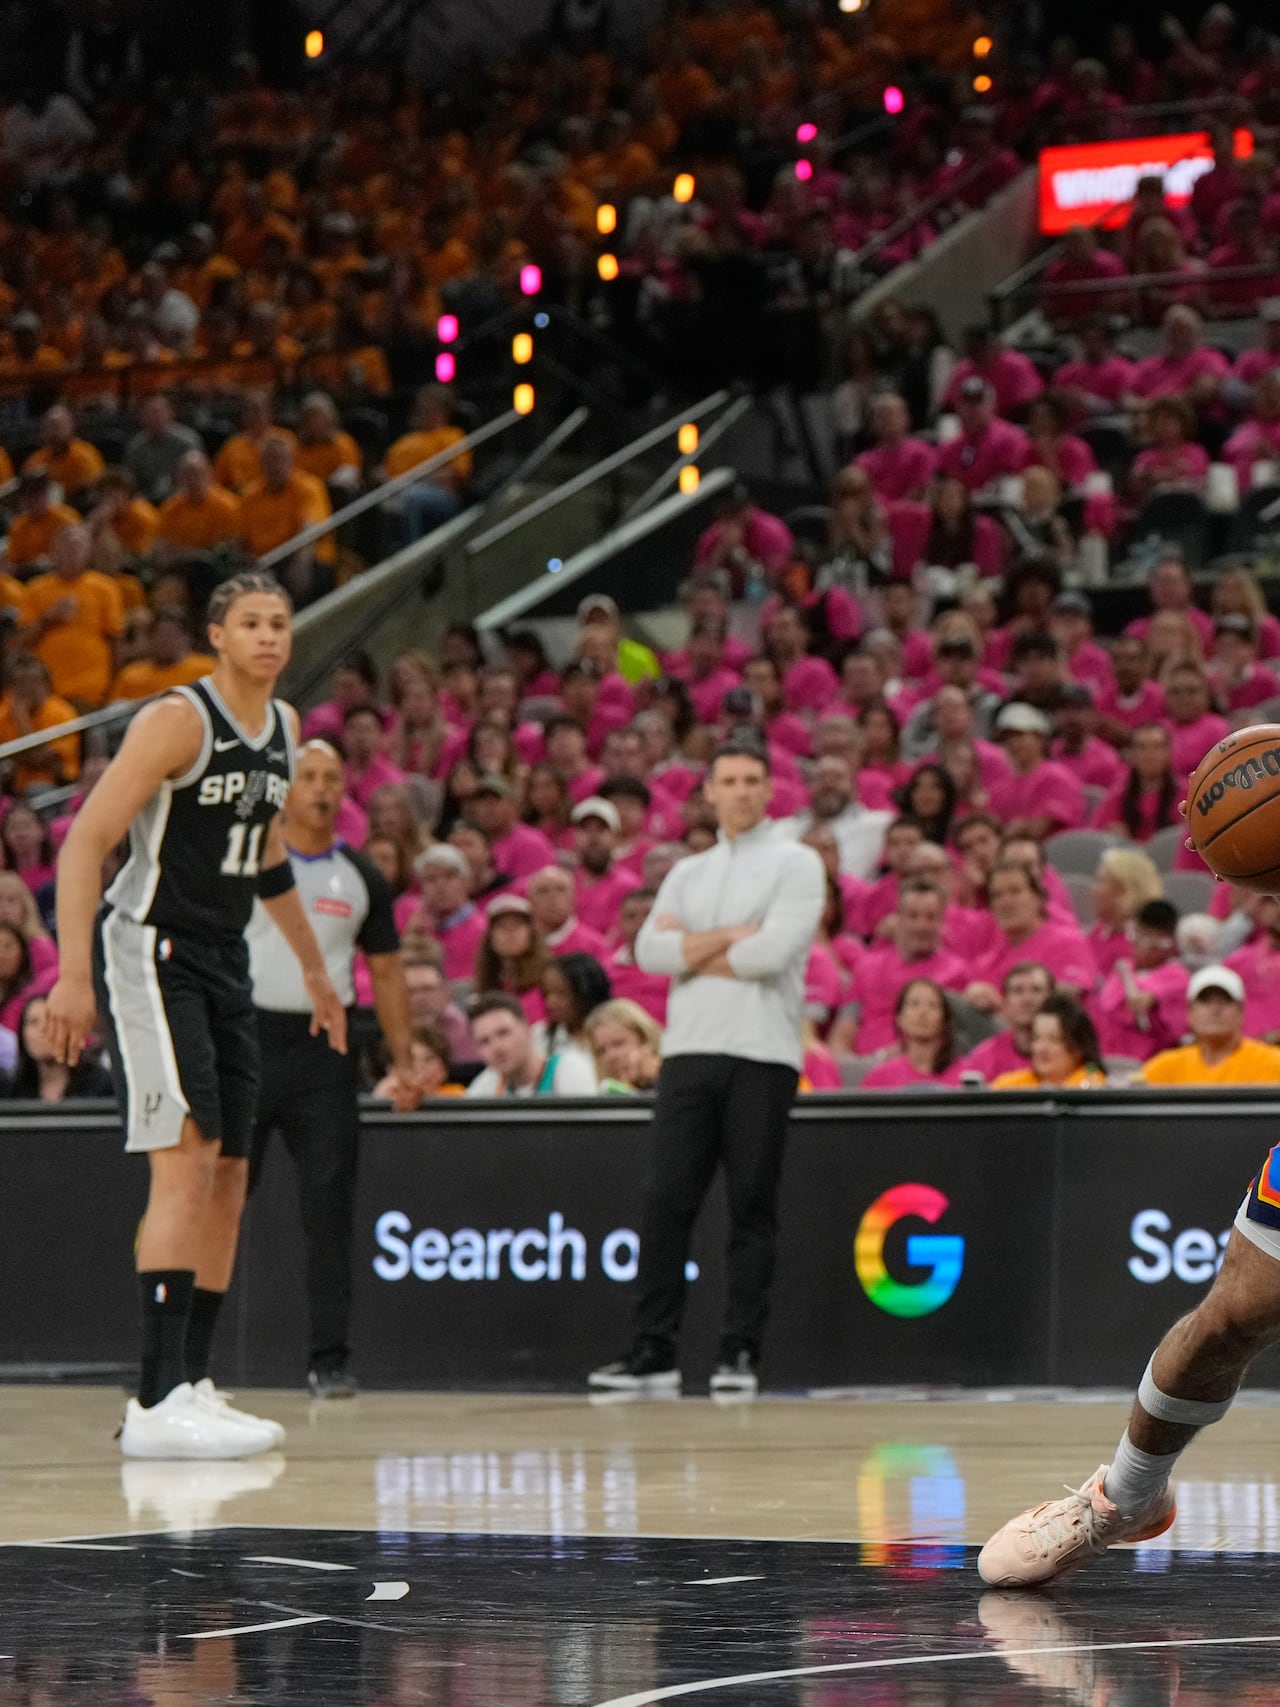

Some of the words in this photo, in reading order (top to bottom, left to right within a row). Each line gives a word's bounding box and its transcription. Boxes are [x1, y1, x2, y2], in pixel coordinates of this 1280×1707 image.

[220, 822, 264, 876] 11
[372, 1210, 587, 1282] Search
[600, 1228, 700, 1282] o.
[854, 1183, 964, 1318] G
